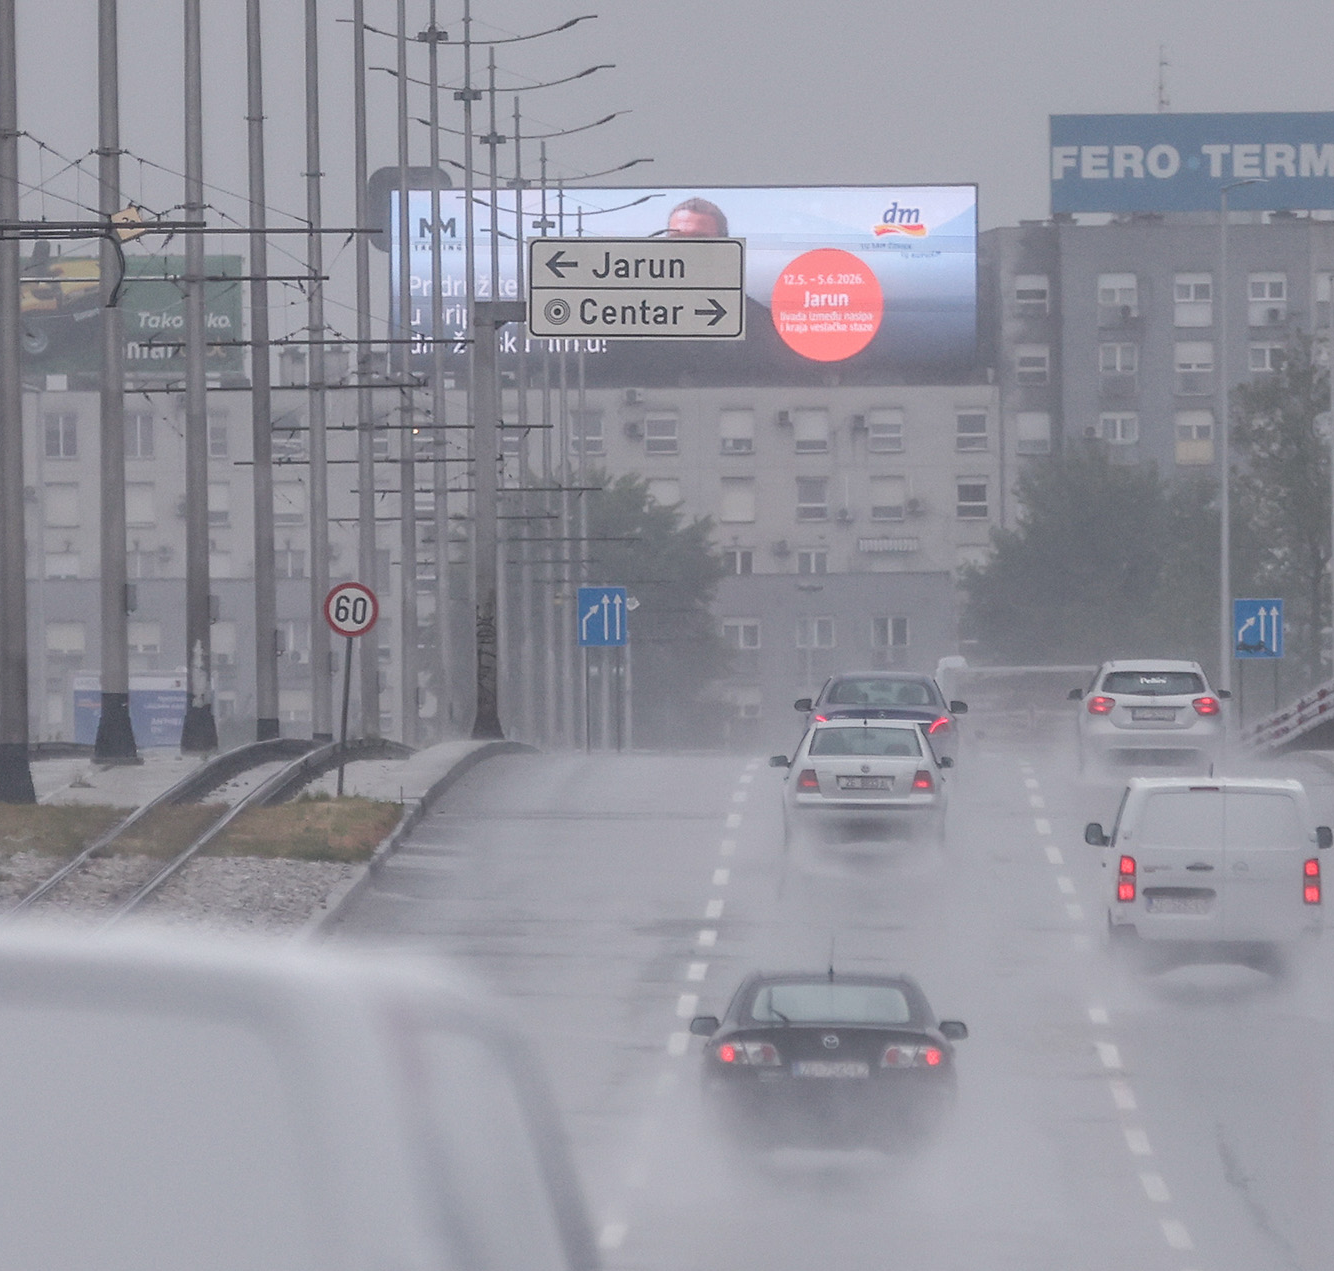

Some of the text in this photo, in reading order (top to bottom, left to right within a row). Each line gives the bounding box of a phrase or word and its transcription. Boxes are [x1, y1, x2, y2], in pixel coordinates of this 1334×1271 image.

[1052, 144, 1181, 180] FERO
[883, 202, 920, 223] dm
[592, 251, 685, 279] Jarun
[784, 274, 807, 285] 12.5.
[818, 274, 866, 285] 5.6.2026.
[803, 291, 849, 308] Jarun
[138, 312, 184, 329] Tako
[579, 299, 683, 326] Centar
[785, 322, 808, 333] kraja
[849, 323, 873, 332] staze
[334, 595, 367, 625] 60
